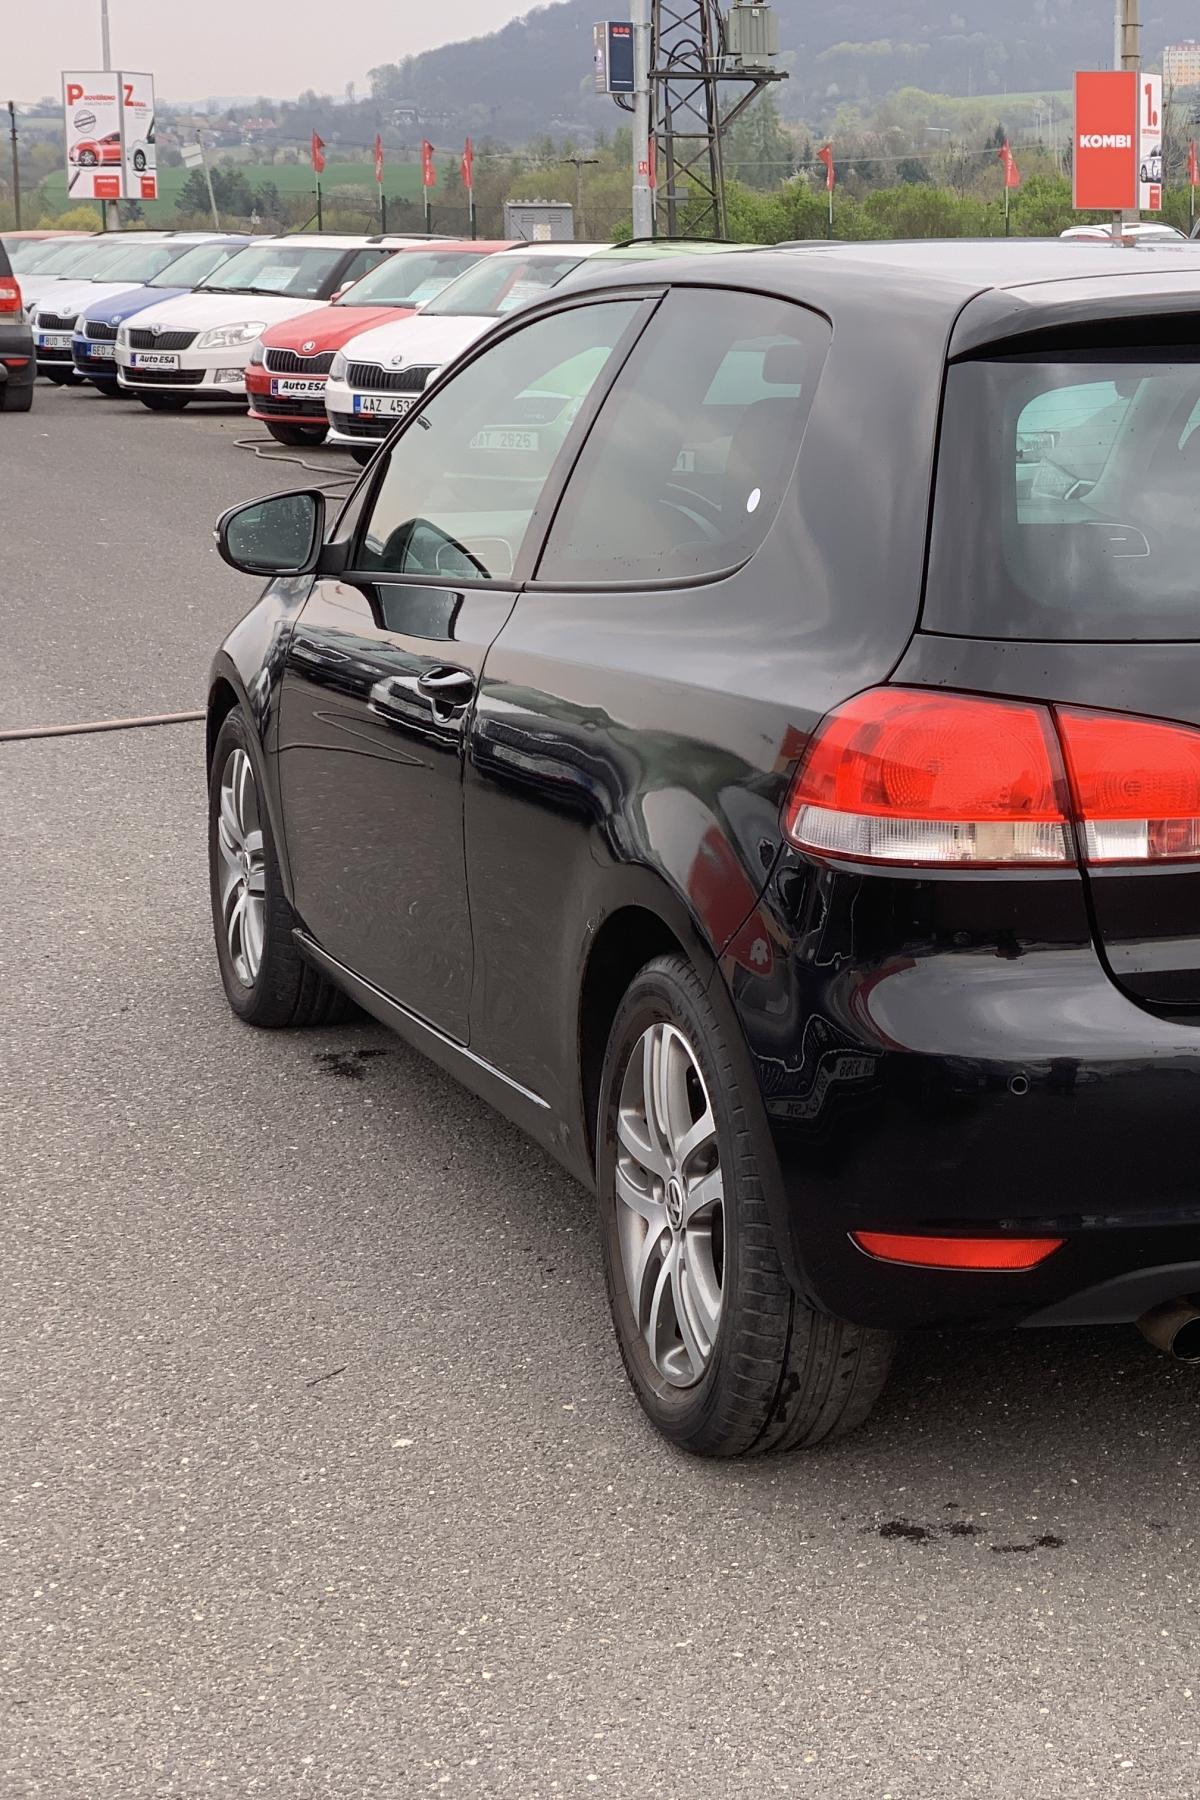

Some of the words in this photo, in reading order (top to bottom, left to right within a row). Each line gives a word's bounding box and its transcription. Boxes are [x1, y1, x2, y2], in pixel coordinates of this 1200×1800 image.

[1080, 134, 1132, 148] KOMBI
[139, 355, 158, 364] Auto
[158, 355, 175, 364] ESA
[282, 380, 306, 390] Auto
[307, 381, 326, 391] ESA
[363, 399, 382, 412] 4AZ
